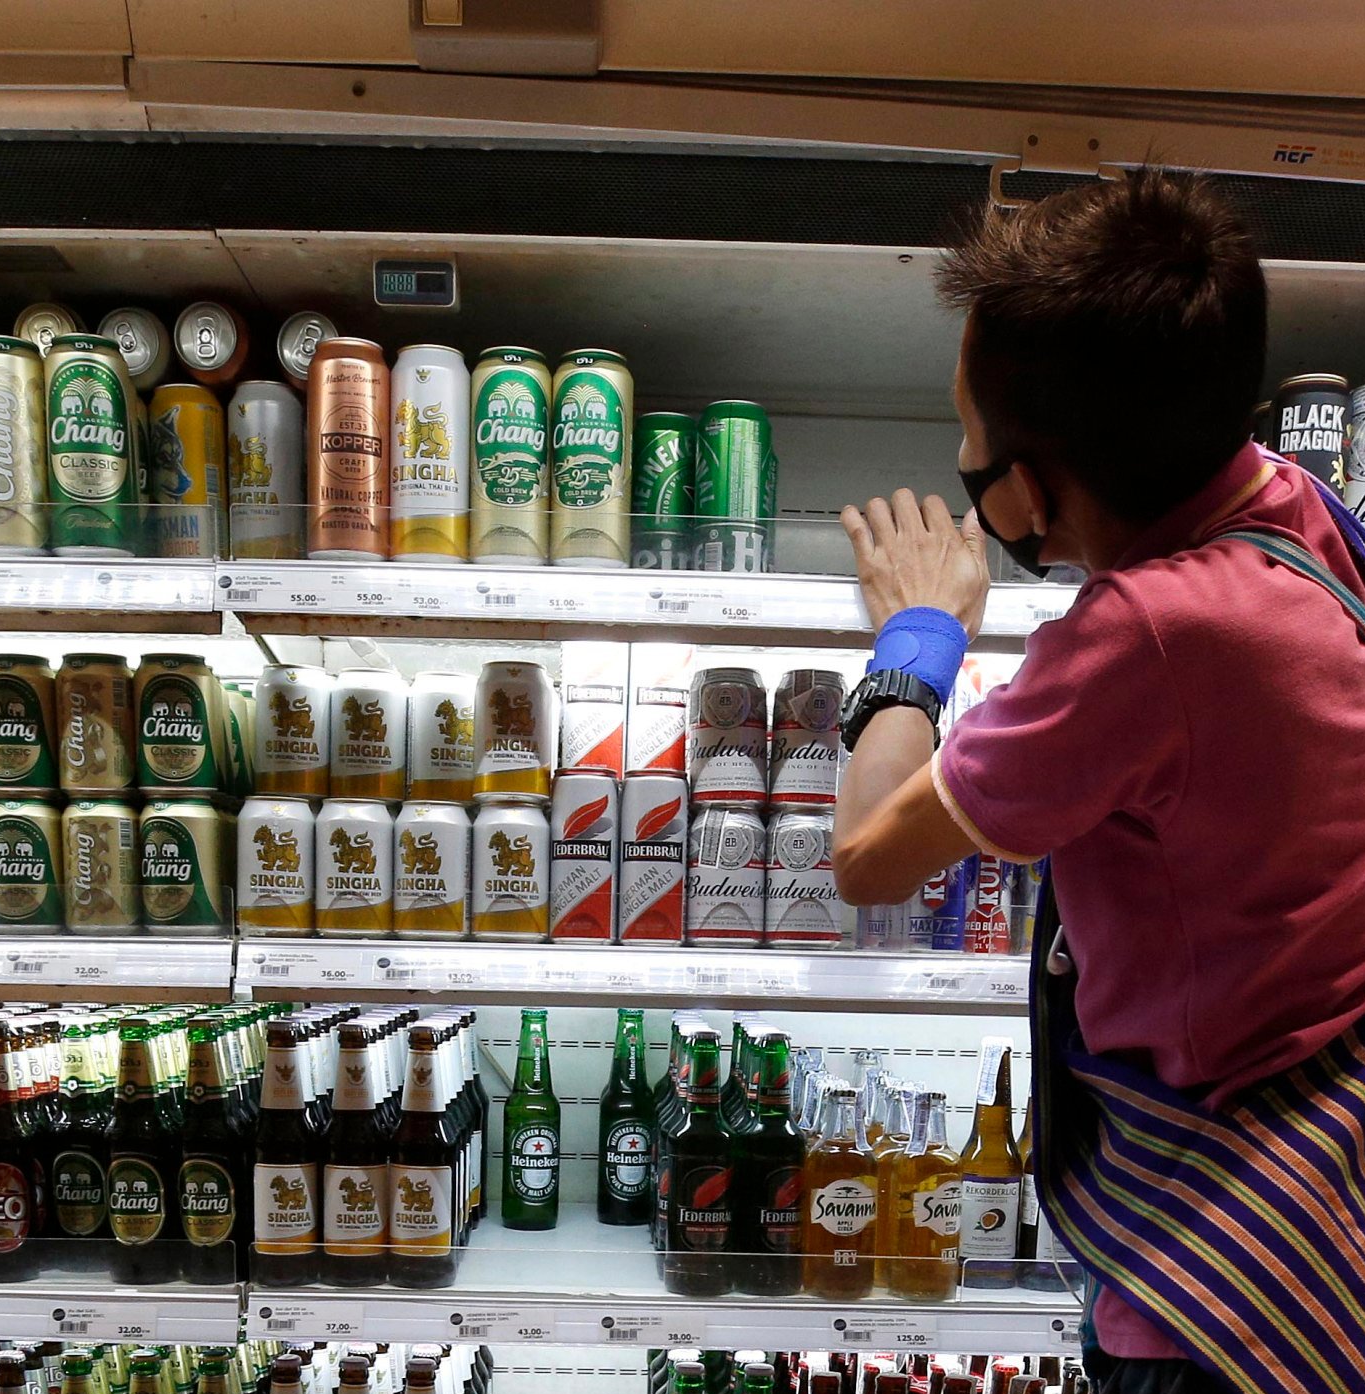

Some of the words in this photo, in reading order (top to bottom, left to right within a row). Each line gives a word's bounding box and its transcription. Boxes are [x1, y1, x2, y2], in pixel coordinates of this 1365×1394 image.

[1281, 405, 1345, 431] BLACK
[51, 416, 125, 451] Chang
[476, 418, 546, 450] Chang
[553, 419, 619, 452] Chang
[1279, 430, 1344, 451] DRAGON
[322, 434, 380, 452] KOPPER
[60, 455, 119, 472] CLASSIC
[339, 458, 366, 467] CRAFT
[392, 464, 459, 484] SINGHA
[290, 593, 317, 604] 55.00
[356, 593, 383, 603] 55.00
[721, 607, 747, 617] 61.00
[266, 740, 319, 755] SINGHA
[339, 744, 392, 759] SINGHA
[624, 842, 682, 860] FEDERBRÄU
[250, 875, 305, 889] SINGHA
[326, 877, 381, 891] SINGHA
[484, 879, 539, 894] SINGHA
[990, 984, 1015, 992] 32.00
[834, 1250, 857, 1265] DRY
[118, 1326, 142, 1334] 32.00
[325, 1323, 350, 1331] 37.00
[517, 1327, 542, 1335] 43.00
[668, 1333, 691, 1341] 38.00
[896, 1334, 925, 1342] 125.00
